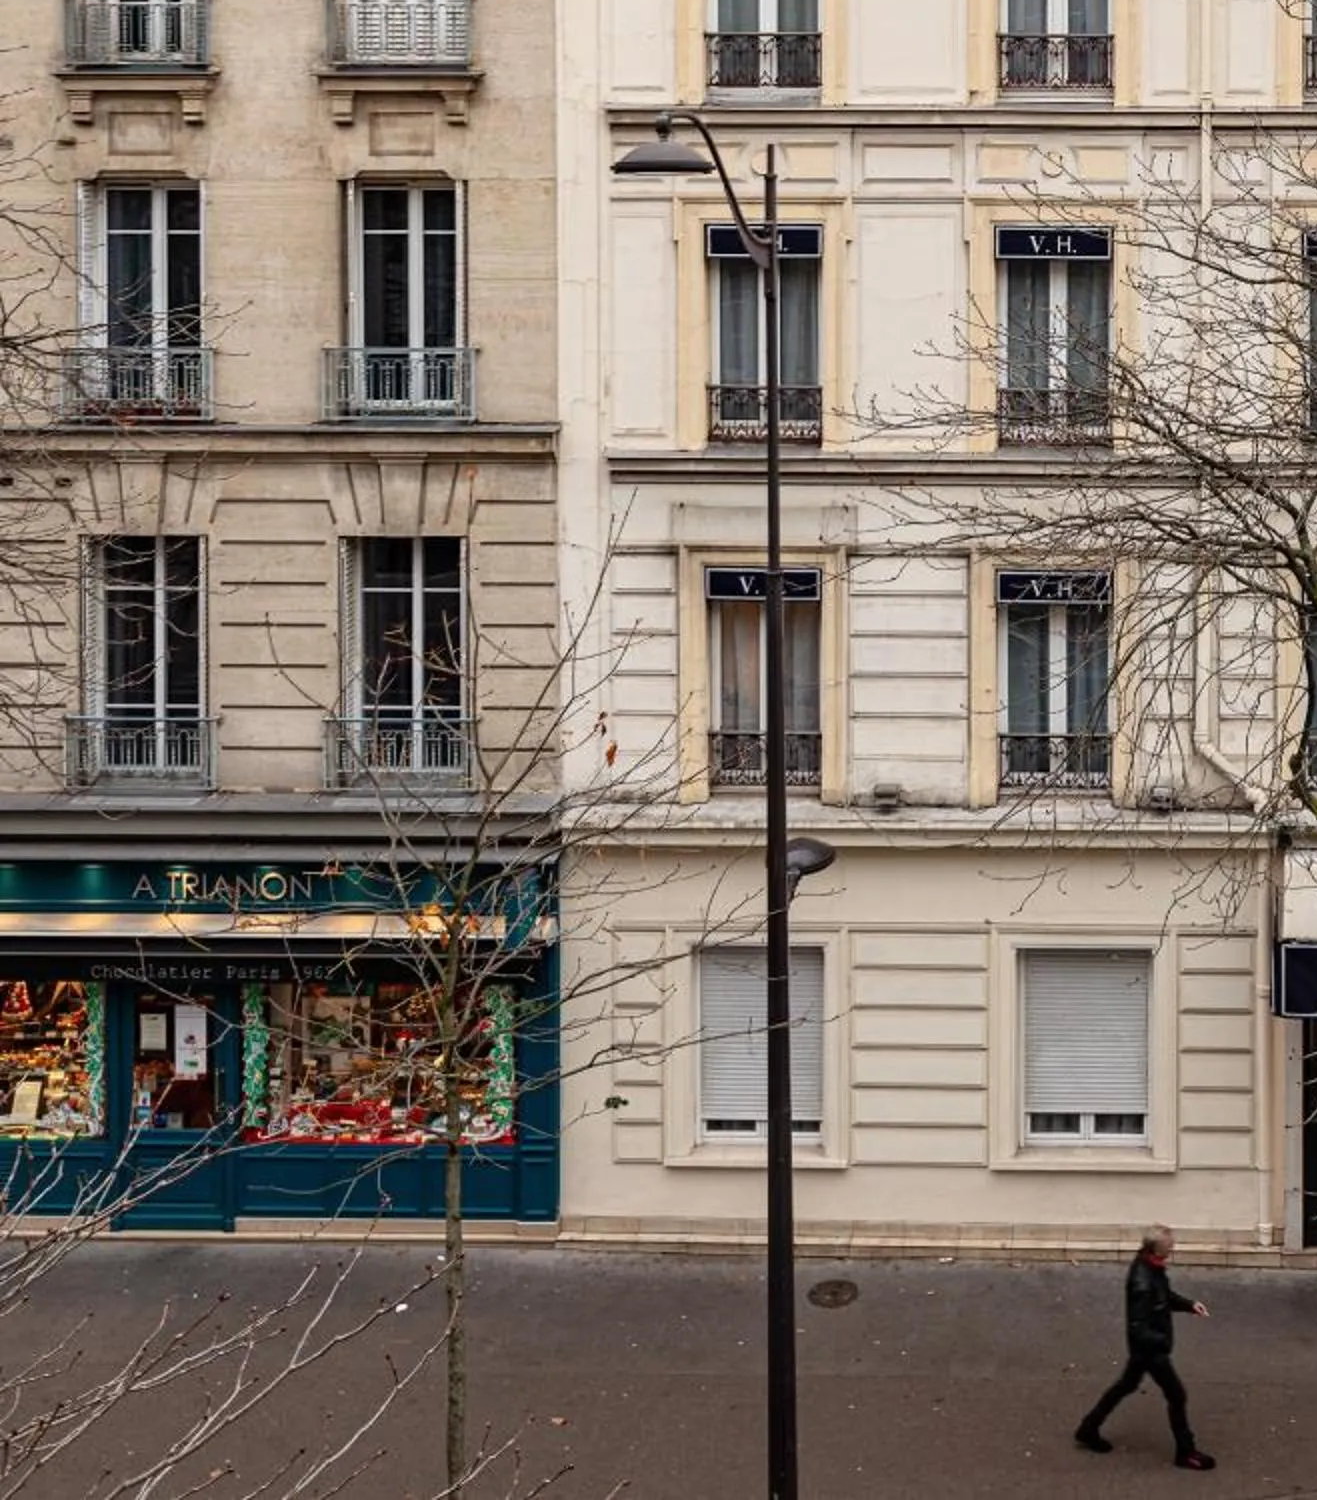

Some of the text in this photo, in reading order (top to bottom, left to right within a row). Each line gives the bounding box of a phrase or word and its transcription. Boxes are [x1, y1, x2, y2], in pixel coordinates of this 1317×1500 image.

[132, 871, 312, 900] A TRIANON
[90, 964, 213, 980] Chocolatier
[226, 964, 280, 980] Paris
